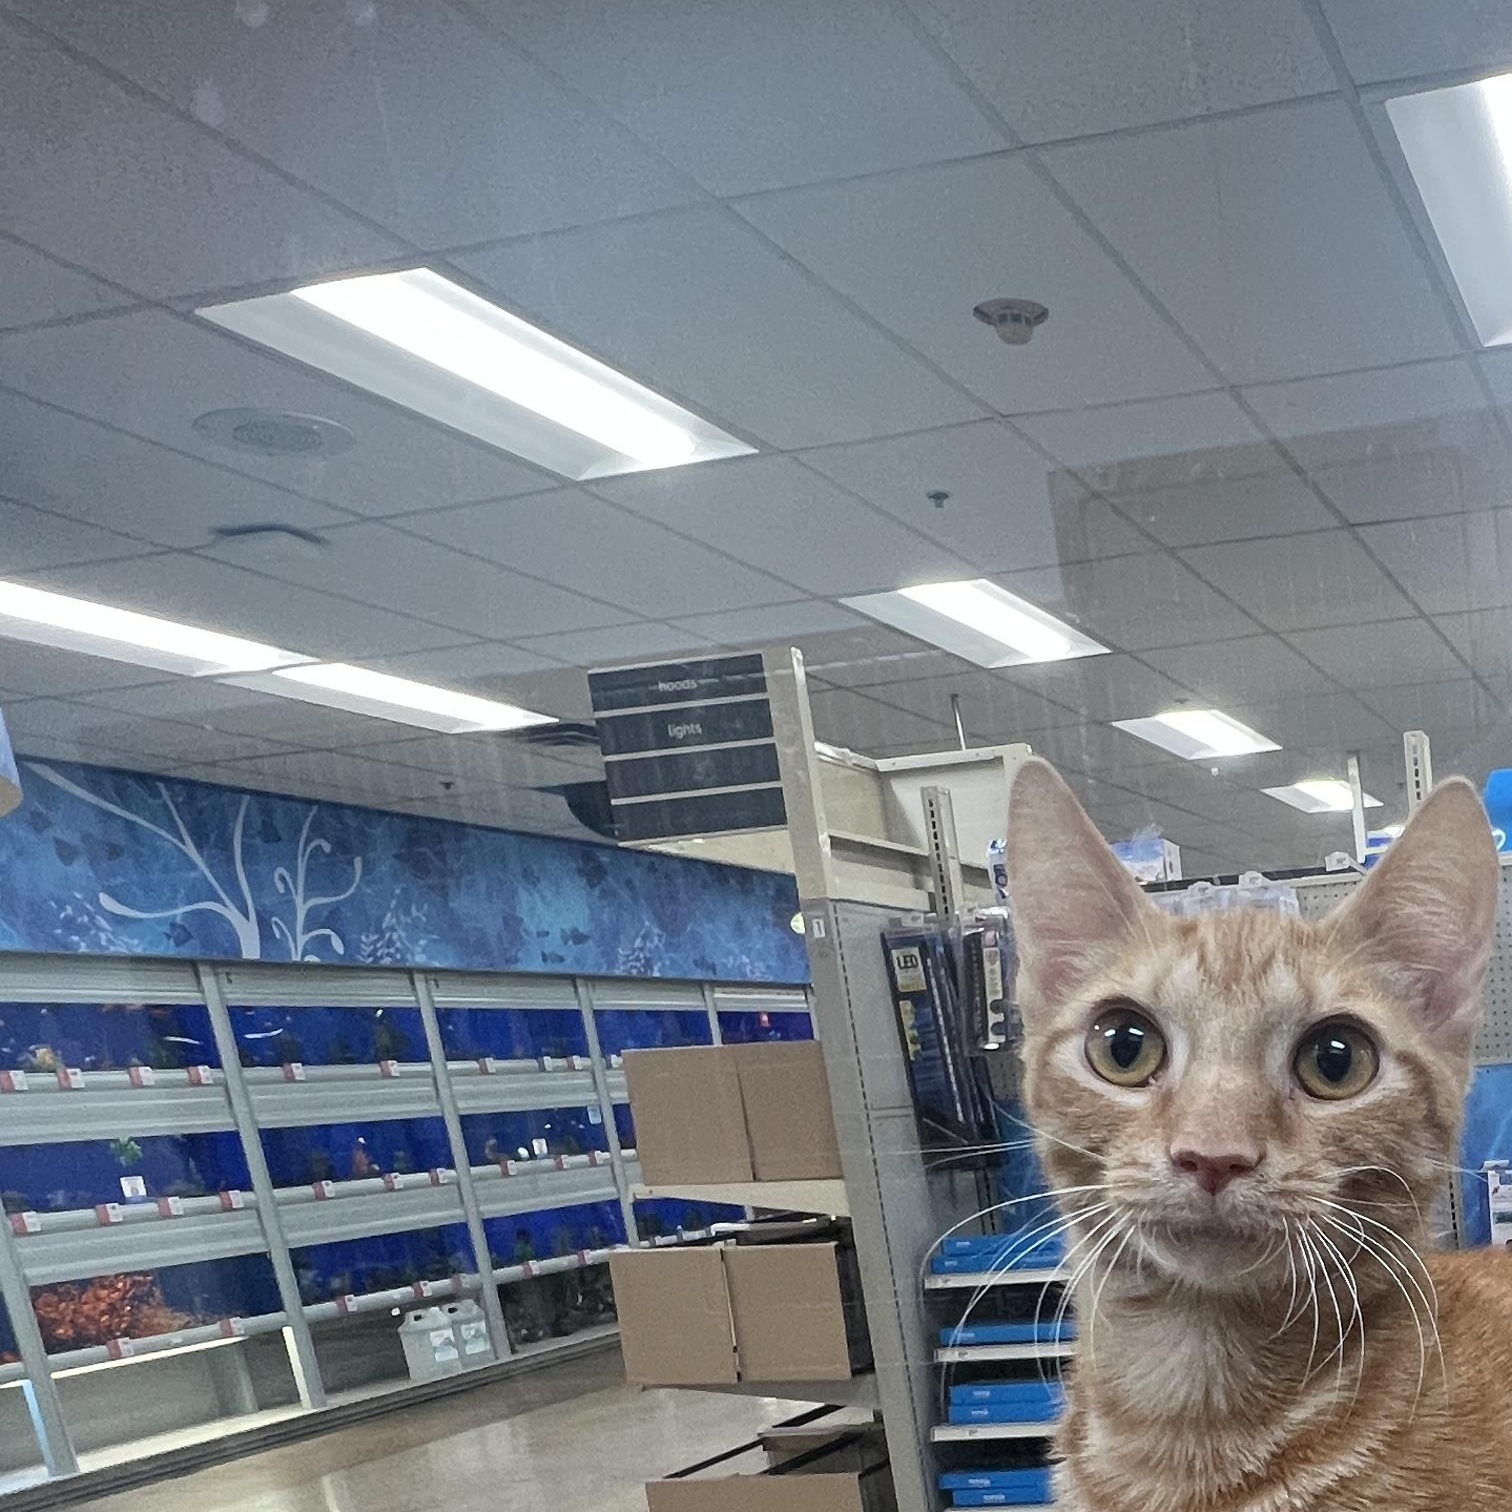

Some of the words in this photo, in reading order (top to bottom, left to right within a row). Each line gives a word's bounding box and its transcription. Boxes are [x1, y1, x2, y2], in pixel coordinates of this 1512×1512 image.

[658, 678, 699, 693] hoods
[667, 723, 702, 739] lights
[897, 955, 918, 969] LED
